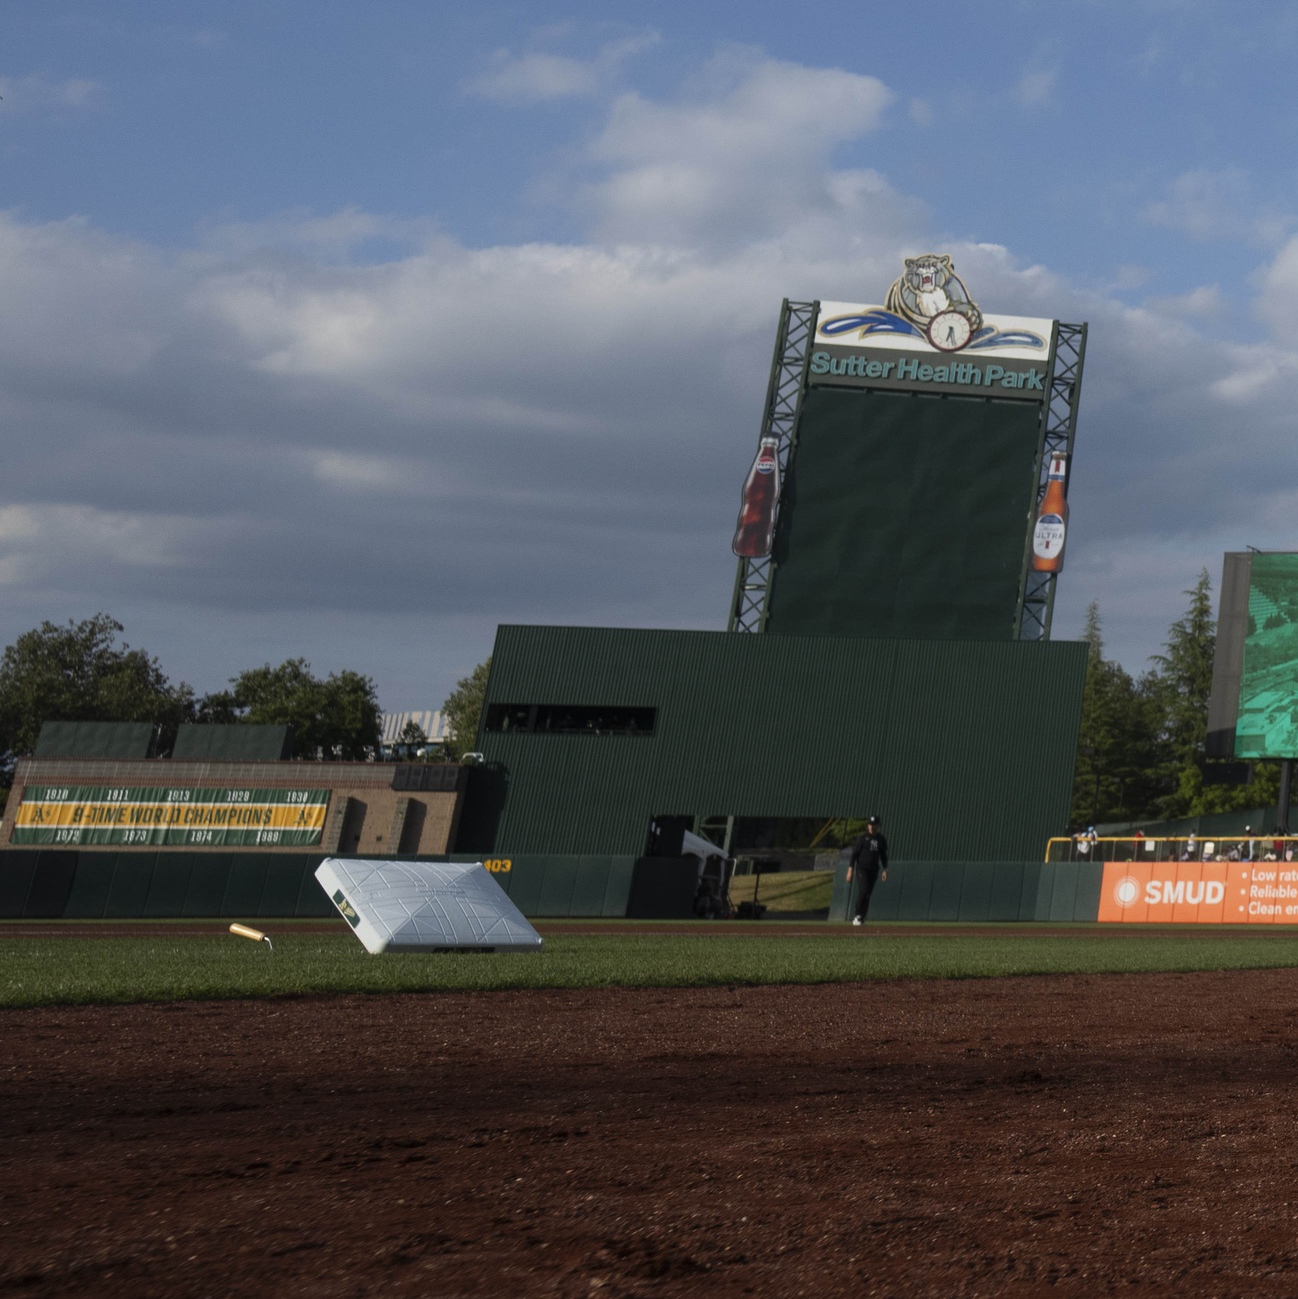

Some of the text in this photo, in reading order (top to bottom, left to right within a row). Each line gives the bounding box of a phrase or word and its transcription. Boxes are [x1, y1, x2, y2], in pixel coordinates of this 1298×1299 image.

[810, 351, 1044, 390] Sutter Health Park
[1035, 532, 1063, 540] ULTRA
[106, 789, 129, 801] 1911
[72, 807, 273, 825] 9-TIME WORLD CHAMPIONS
[123, 830, 147, 842] 1973
[191, 830, 213, 842] 1974
[255, 831, 279, 843] 1989
[1252, 869, 1276, 882] Low
[1144, 880, 1226, 904] SMUD
[1250, 885, 1298, 899] Reliable
[1248, 901, 1282, 915] Clean
